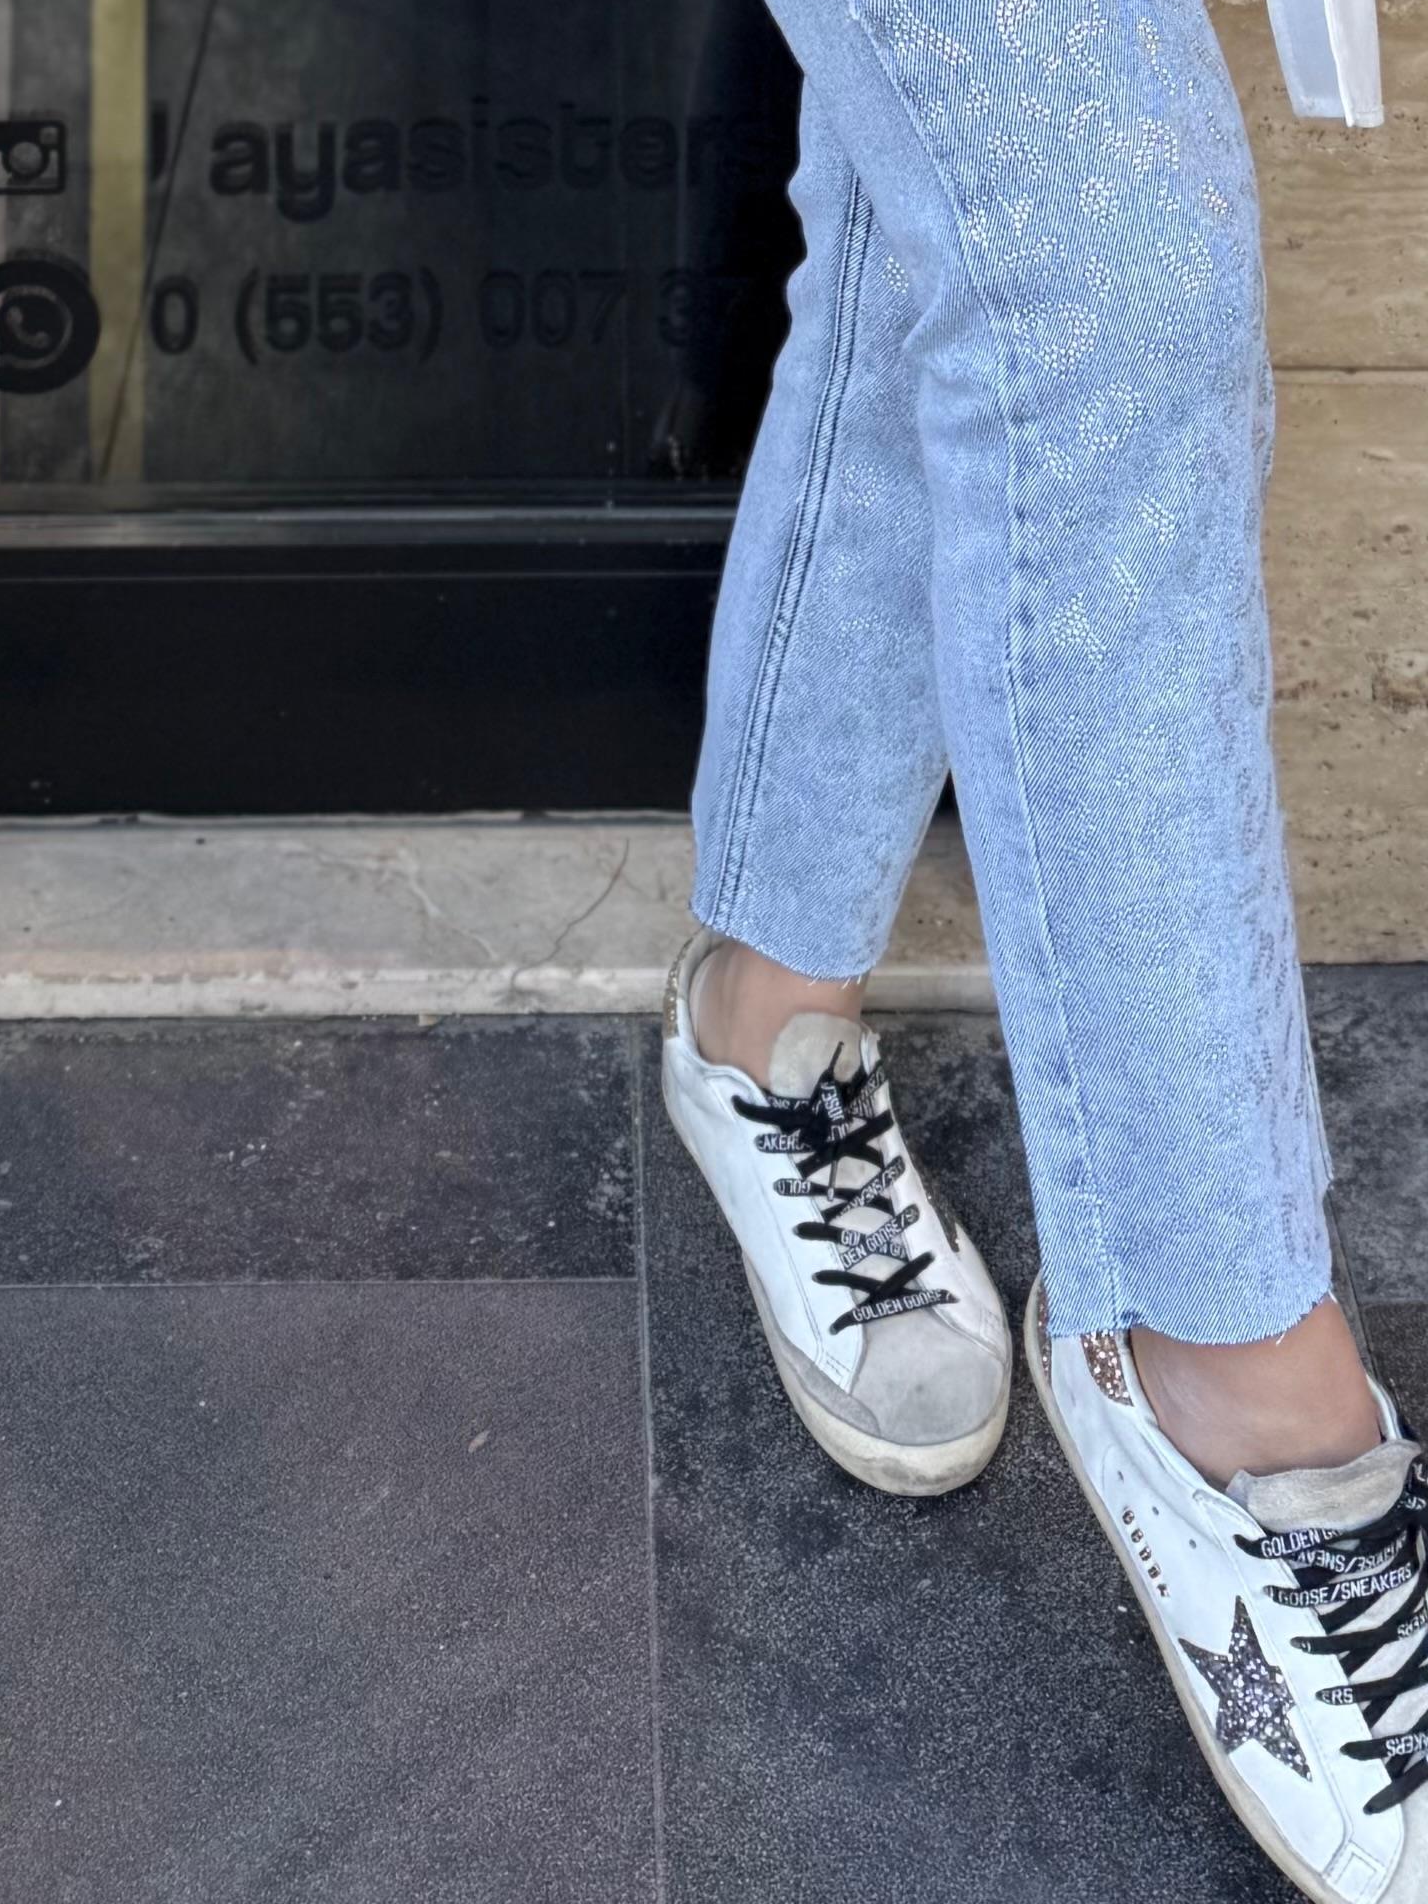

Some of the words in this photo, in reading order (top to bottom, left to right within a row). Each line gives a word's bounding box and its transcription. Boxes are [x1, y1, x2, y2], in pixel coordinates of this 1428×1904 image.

[151, 275, 199, 355] 0
[235, 266, 444, 366] (553)
[479, 268, 628, 351] 007
[852, 1298, 902, 1323] GOLDEN
[1260, 1527, 1322, 1559] GOLDEN
